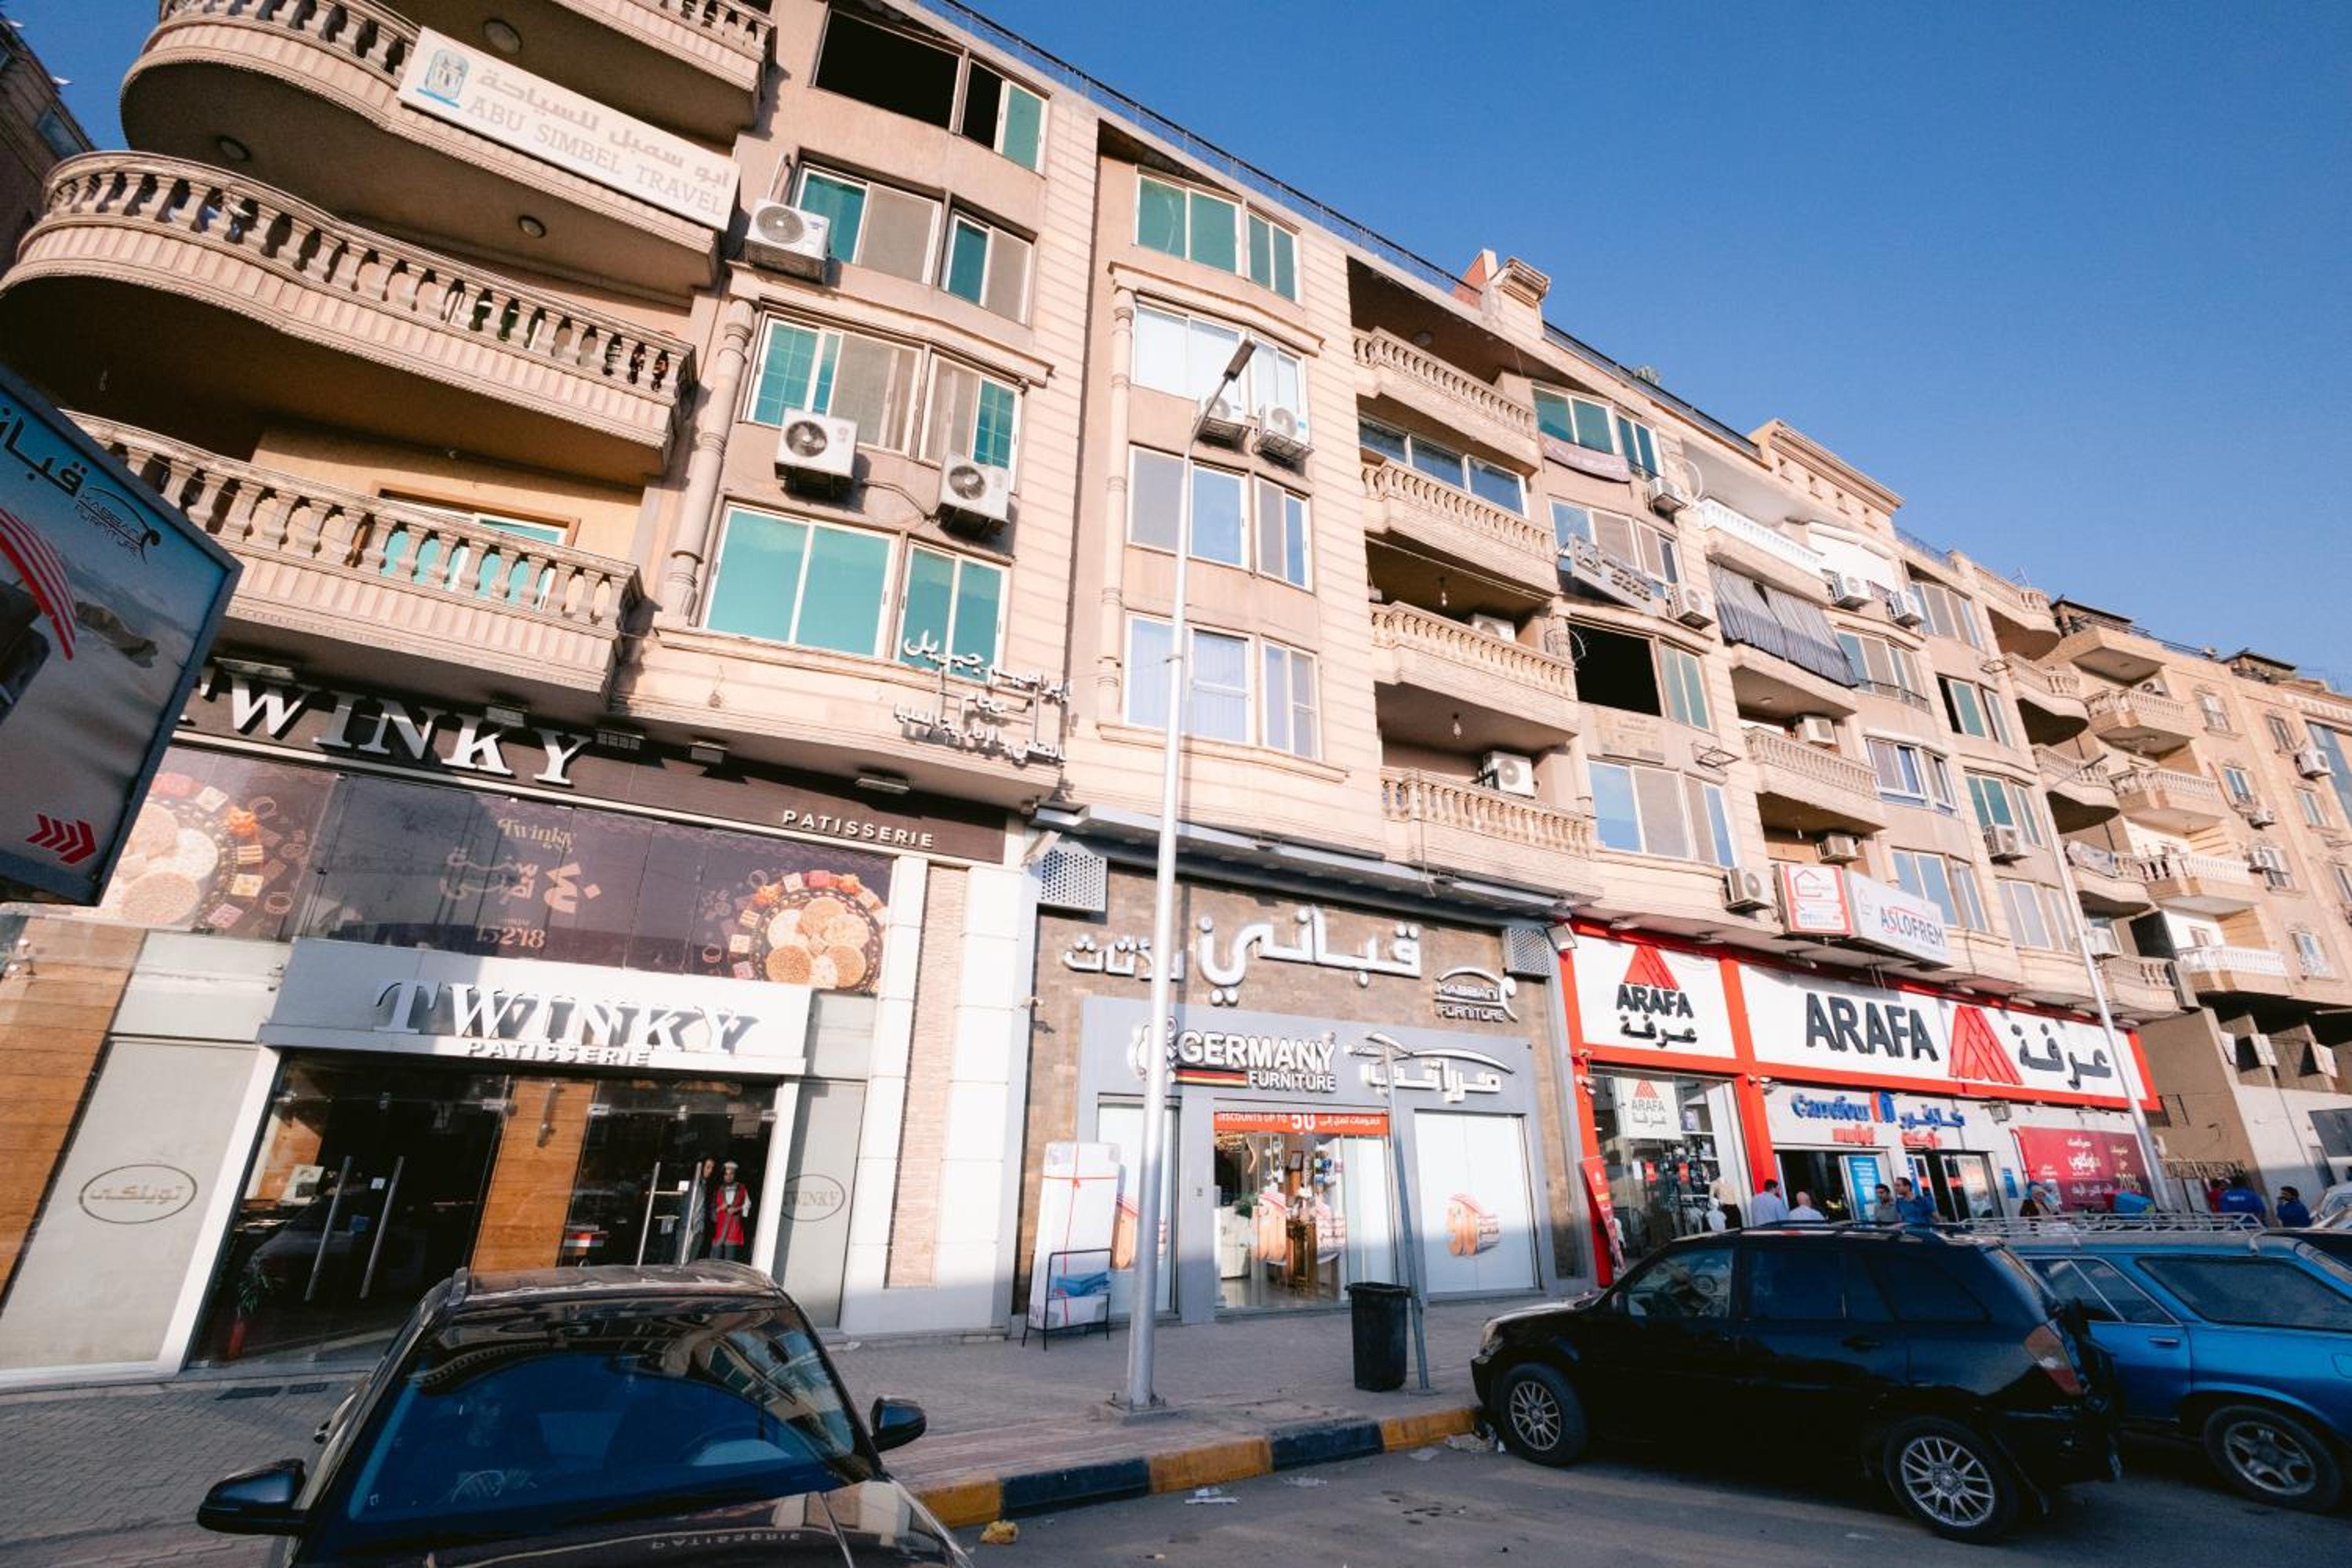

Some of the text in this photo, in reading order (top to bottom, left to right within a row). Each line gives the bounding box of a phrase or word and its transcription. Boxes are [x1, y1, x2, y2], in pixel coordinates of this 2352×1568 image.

[467, 96, 726, 216] ABU SIMBEL TRAVEL
[180, 668, 593, 785] WINKY
[782, 810, 934, 848] PATISSERIE
[373, 978, 751, 1055] TWINKY
[1439, 1004, 1506, 1022] FURNITURE
[1616, 983, 1694, 1019] ARAFA
[1619, 1014, 1698, 1049] عرفة
[1806, 991, 1940, 1062] ARAFA
[469, 1040, 653, 1066] PATISSERIE
[1178, 1030, 1336, 1073] GERMANY
[2010, 1022, 2112, 1091] عرفة
[1247, 1070, 1337, 1092] FURNITURE
[1631, 1099, 1666, 1112] ARAFA
